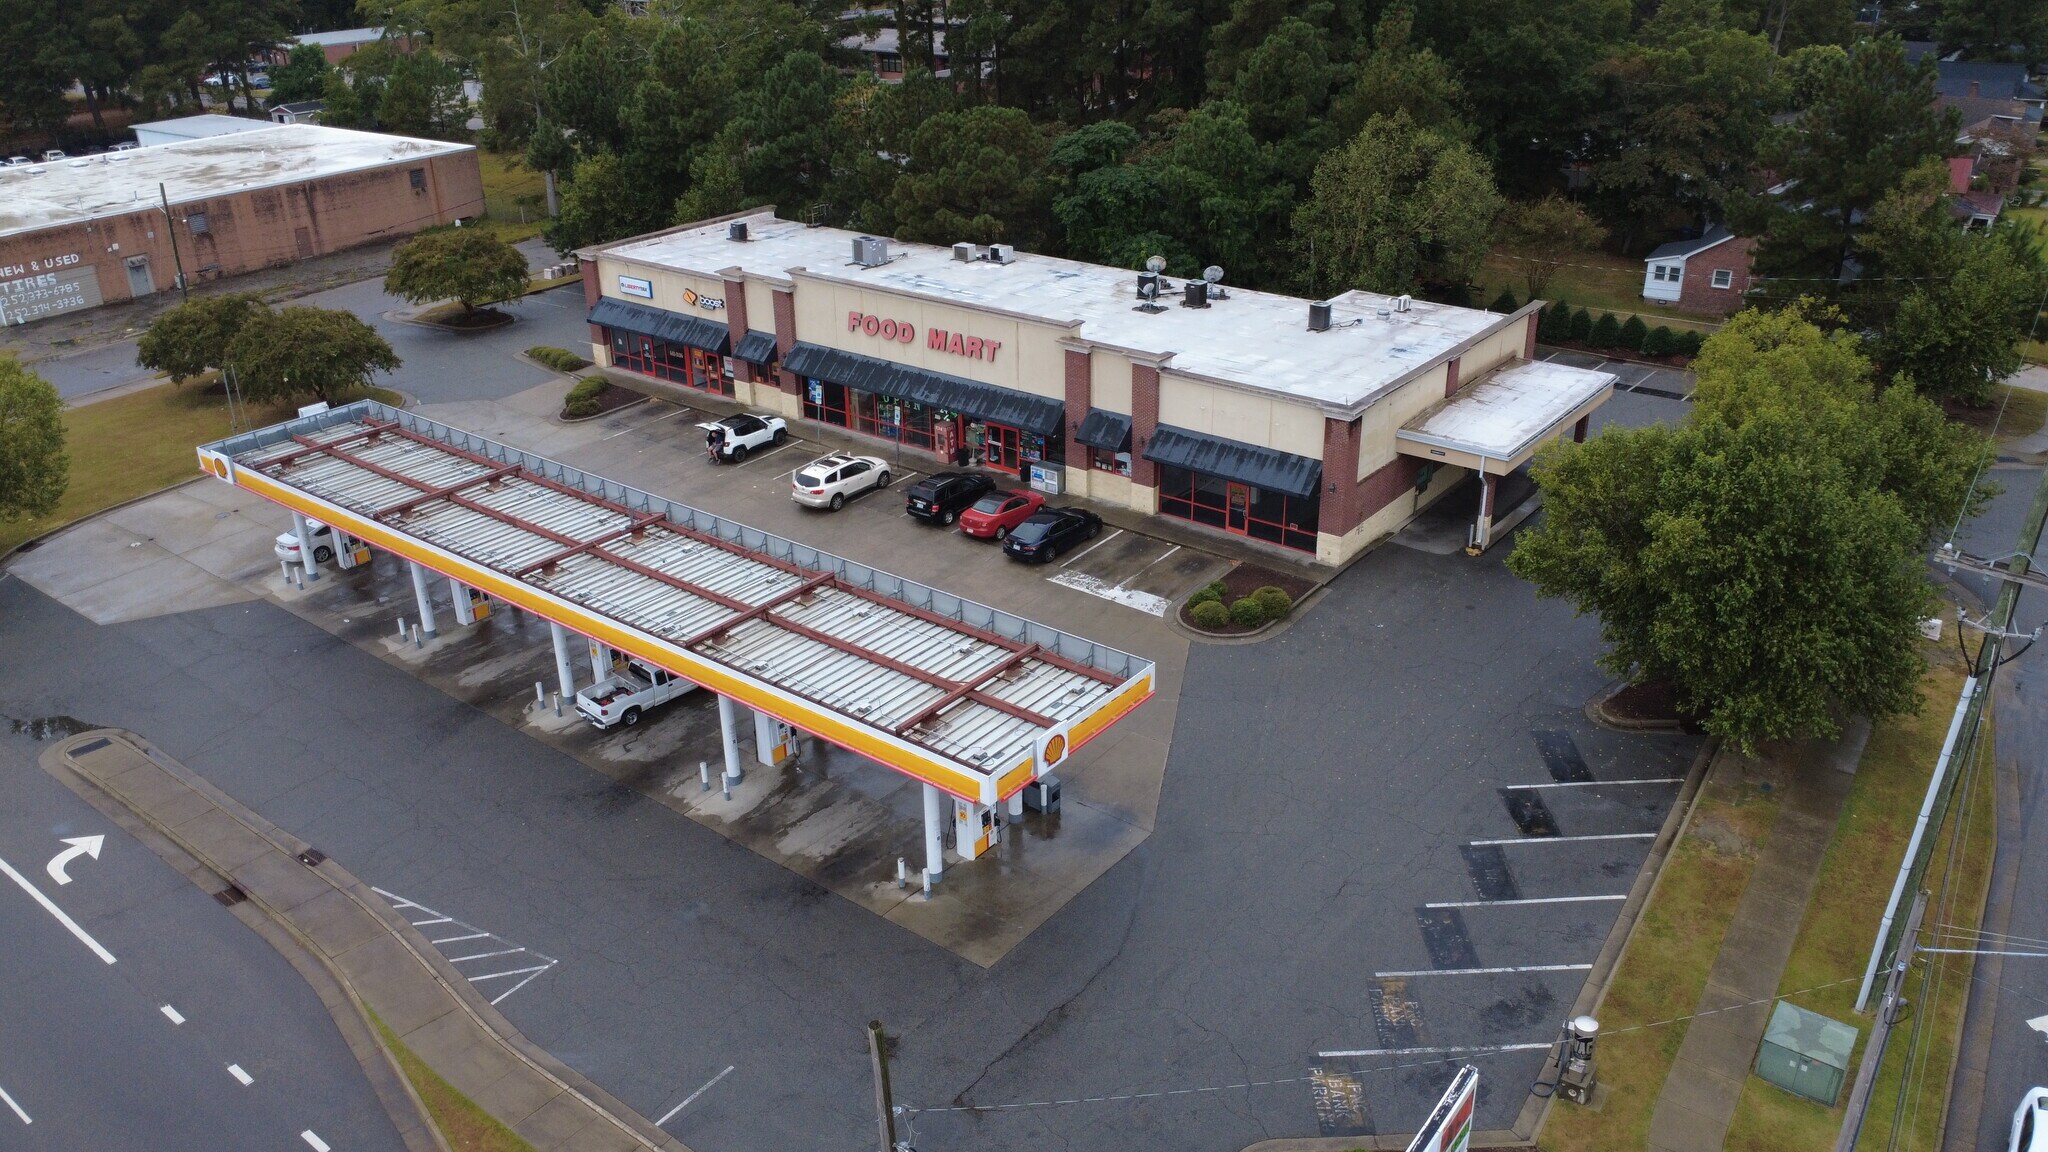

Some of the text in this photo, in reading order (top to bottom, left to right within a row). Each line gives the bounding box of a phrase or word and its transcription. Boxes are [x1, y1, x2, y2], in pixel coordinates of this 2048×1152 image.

[31, 261, 40, 271] &
[44, 253, 79, 268] USED
[0, 272, 57, 294] TIRES
[700, 295, 724, 308] boost
[848, 311, 1001, 362] FOOD MART
[1327, 1078, 1352, 1119] BANK
